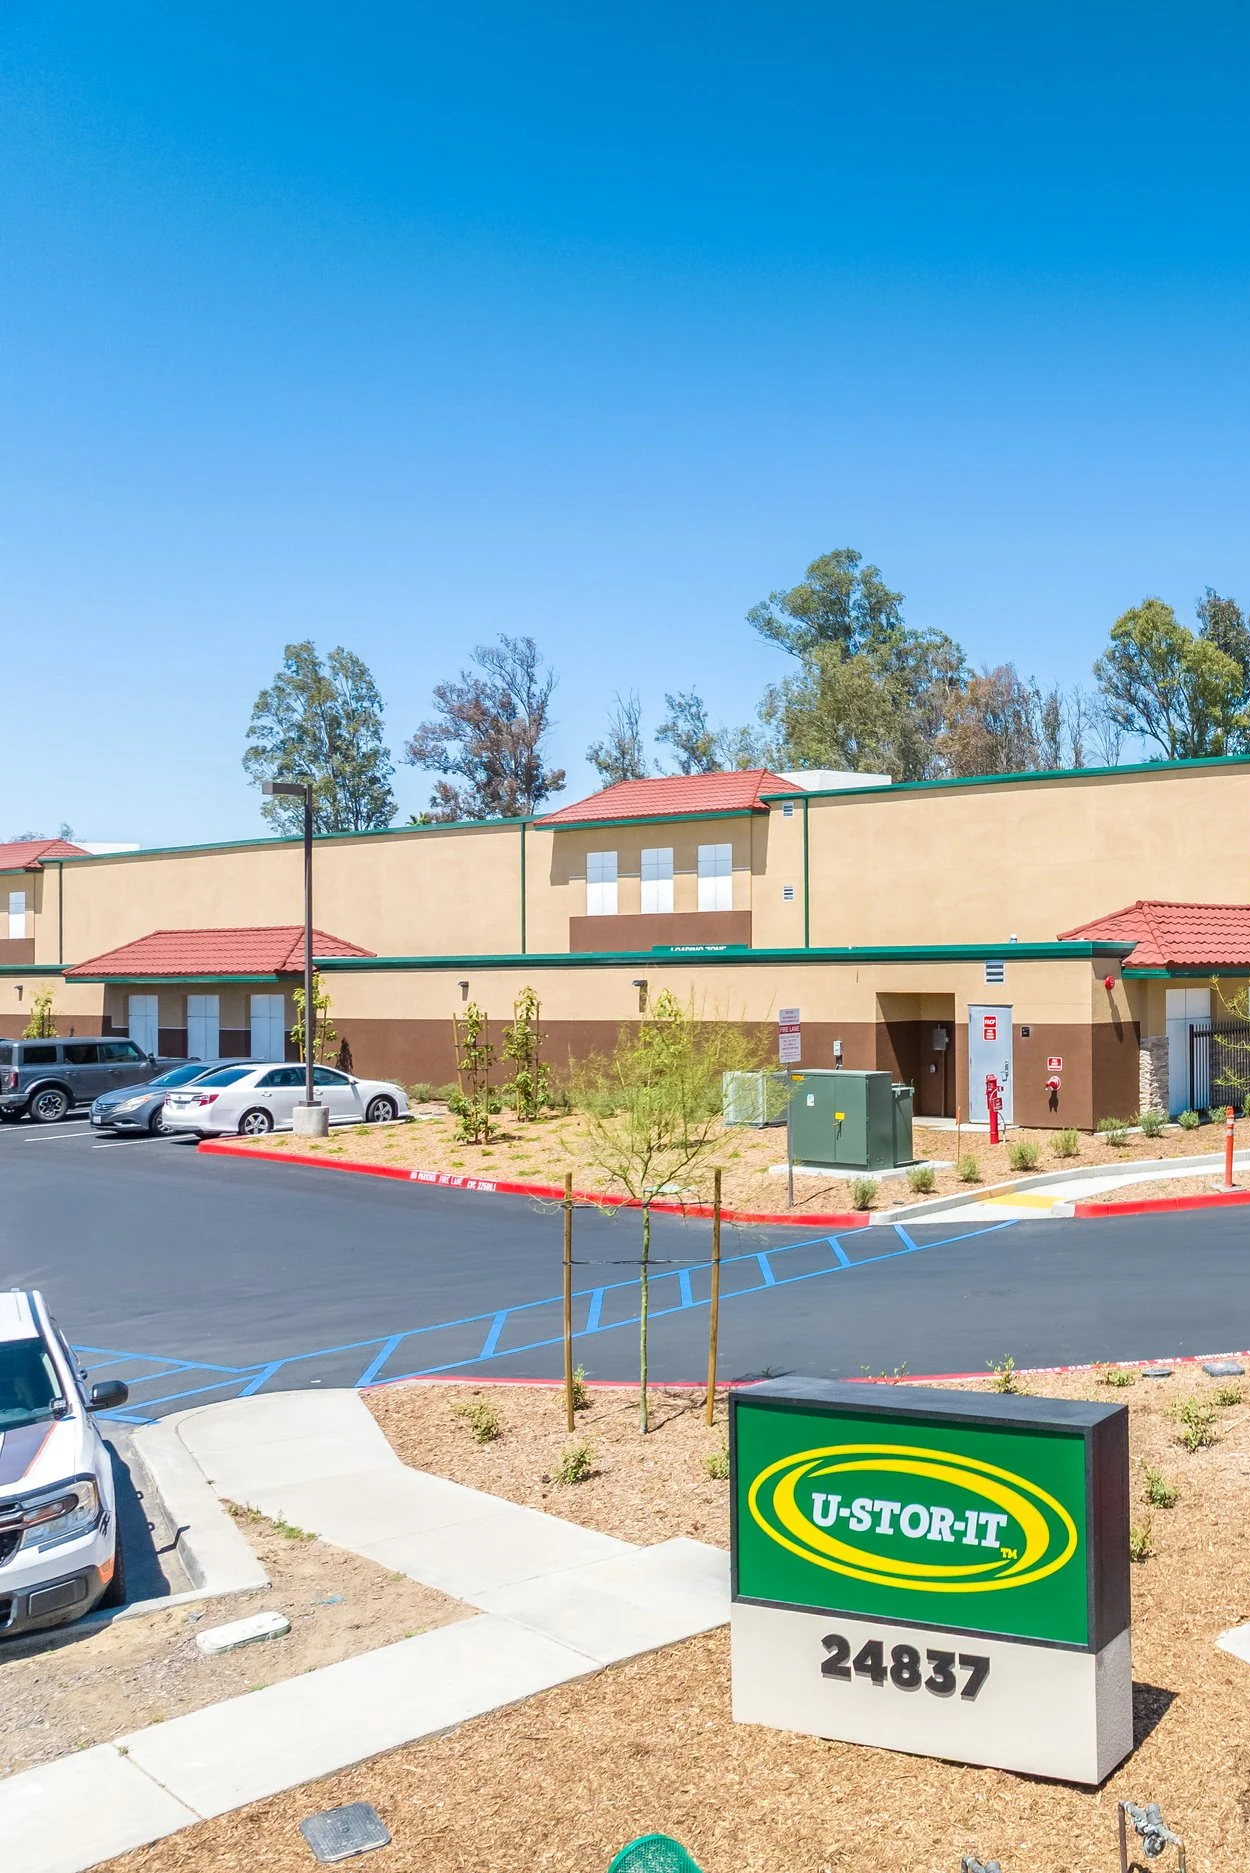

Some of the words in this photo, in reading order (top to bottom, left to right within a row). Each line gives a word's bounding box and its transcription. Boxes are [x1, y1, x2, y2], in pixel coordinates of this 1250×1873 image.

[418, 1172, 437, 1182] PARKING
[439, 1175, 450, 1184] FIRE
[450, 1176, 464, 1186] LANE
[466, 1180, 477, 1189] CVC
[1194, 1352, 1242, 1360] PARKING
[812, 1493, 1008, 1548] U-STOR-IT
[1001, 1548, 1018, 1559] TM
[821, 1634, 990, 1701] 24837
